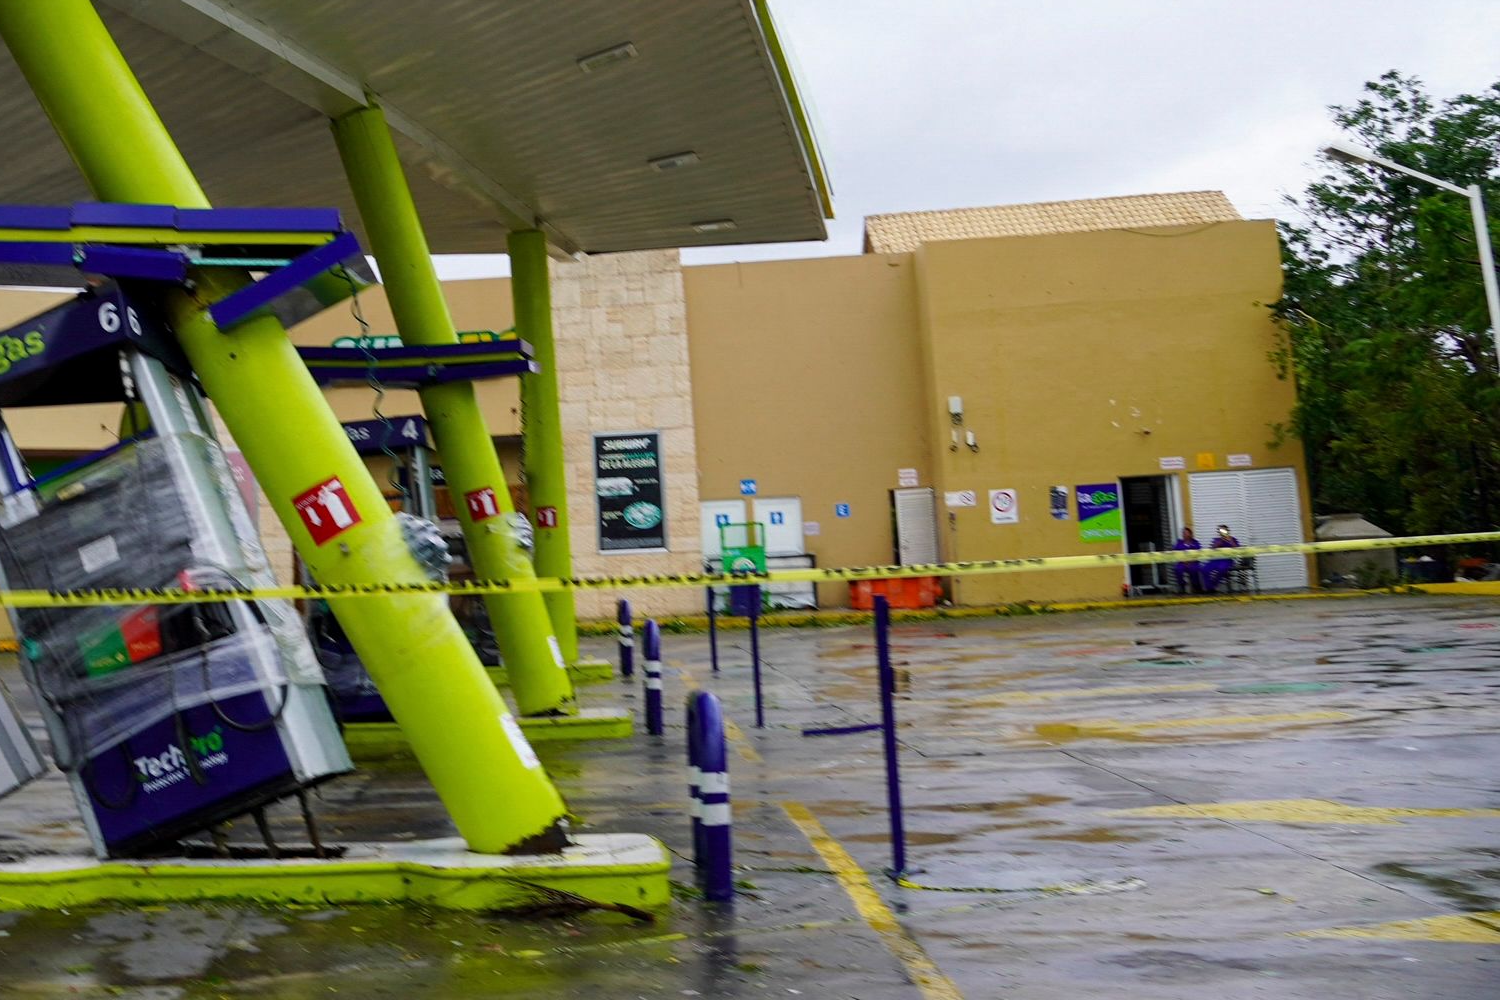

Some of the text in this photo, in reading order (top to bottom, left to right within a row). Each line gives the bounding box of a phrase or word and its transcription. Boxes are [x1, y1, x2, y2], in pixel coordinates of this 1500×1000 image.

[98, 302, 121, 333] 6
[126, 306, 142, 337] 6
[402, 419, 419, 440] 4
